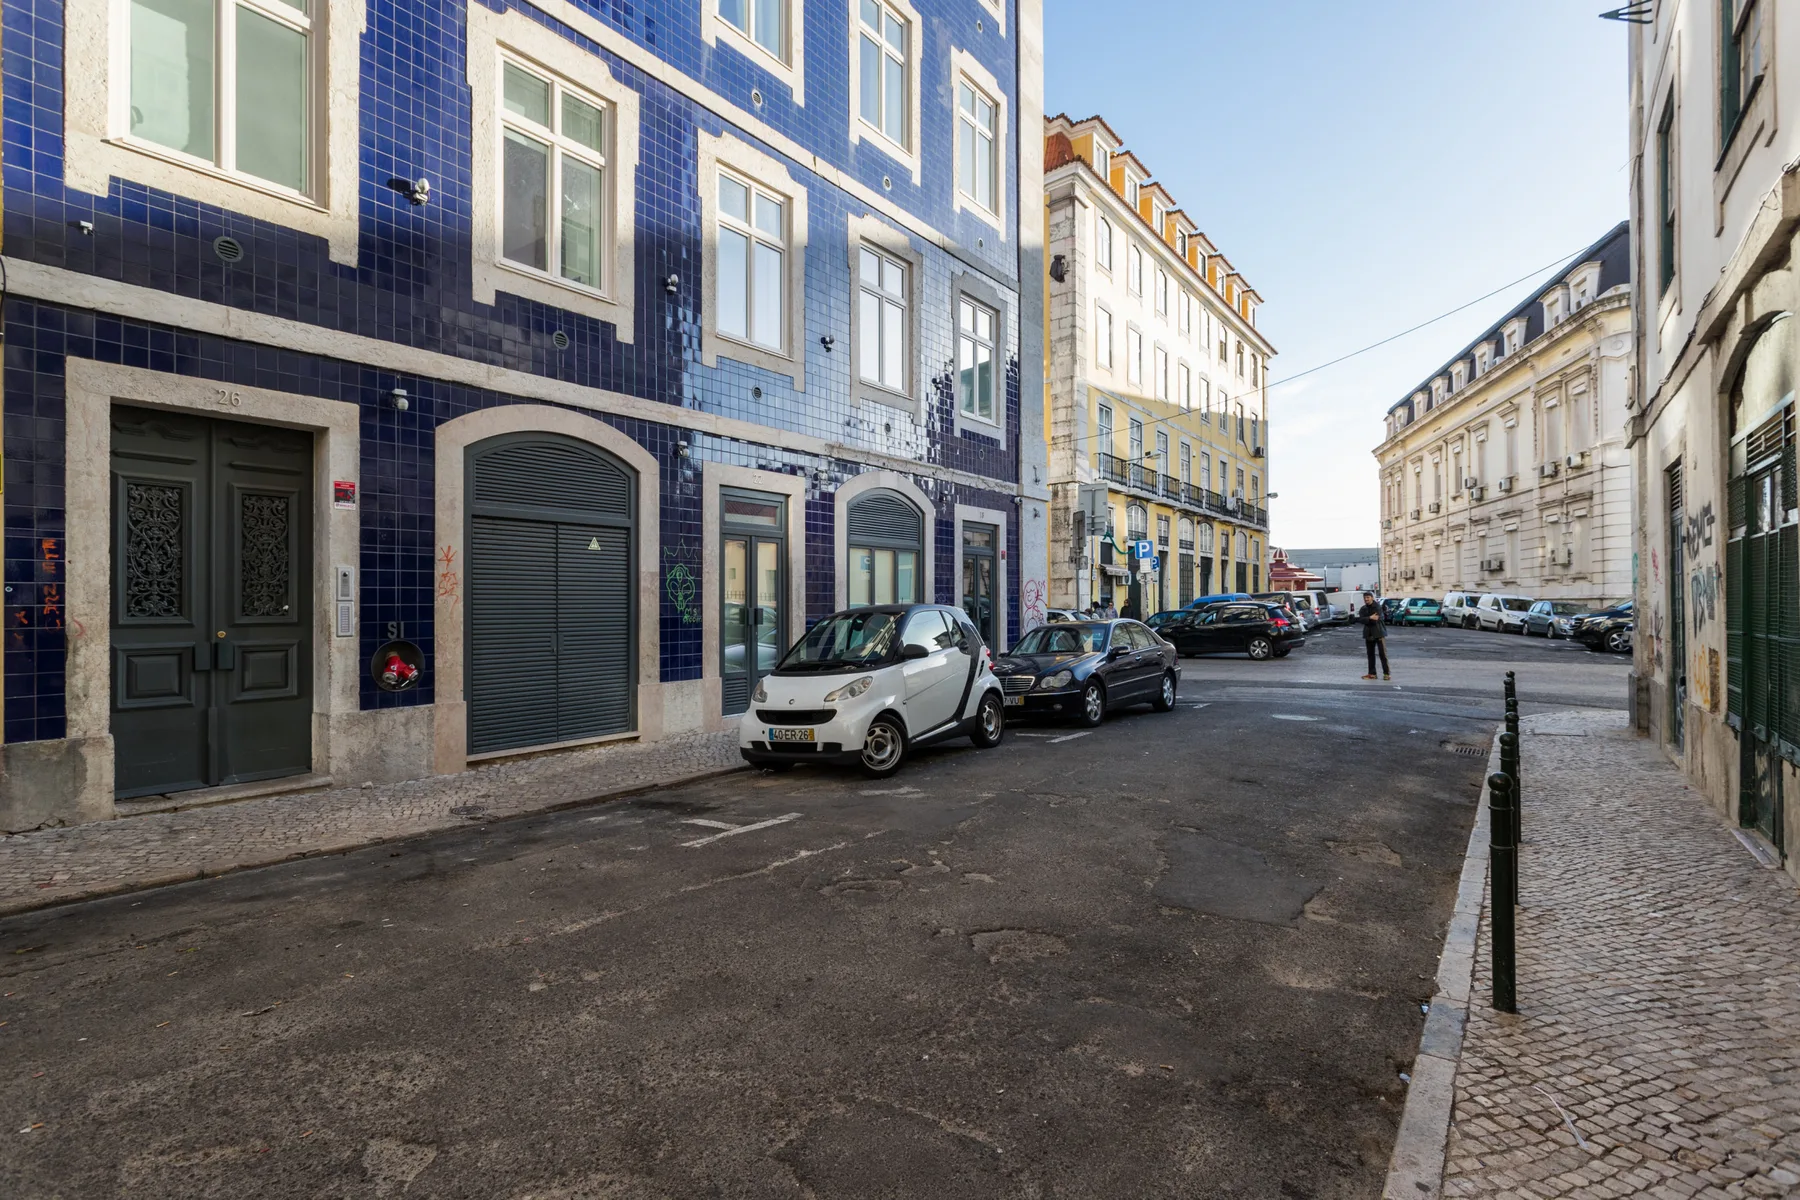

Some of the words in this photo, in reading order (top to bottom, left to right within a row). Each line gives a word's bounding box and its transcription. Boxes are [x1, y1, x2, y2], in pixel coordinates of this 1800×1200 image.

[217, 388, 242, 407] 26
[1138, 542, 1150, 557] P
[387, 621, 404, 639] SI
